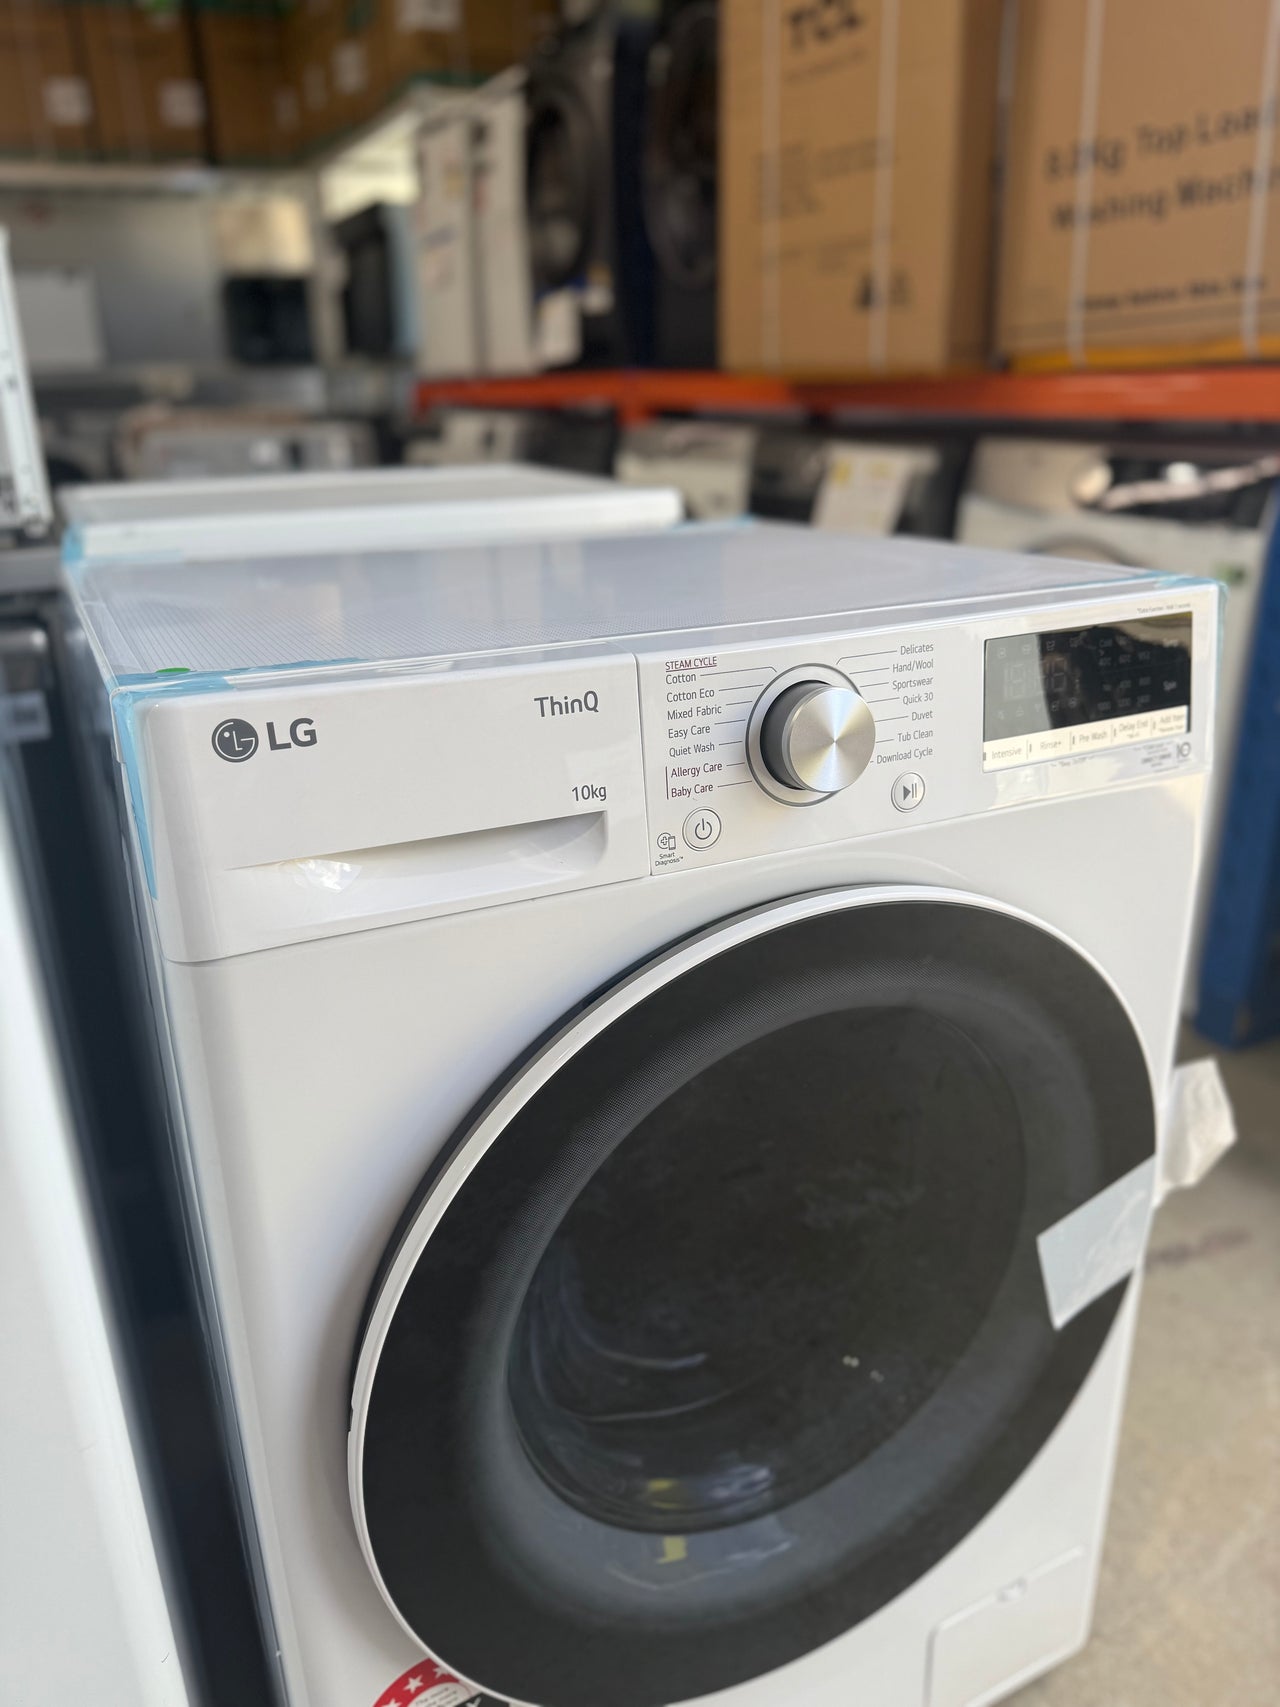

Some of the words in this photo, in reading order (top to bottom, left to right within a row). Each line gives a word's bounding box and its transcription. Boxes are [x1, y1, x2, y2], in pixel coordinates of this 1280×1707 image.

[900, 644, 934, 656] Delicates
[665, 659, 692, 671] STEAM
[693, 656, 717, 668] CYCLE
[892, 659, 934, 673] Hand/Wool
[665, 673, 697, 685] Cotton
[892, 677, 933, 692] Sportswear
[666, 691, 697, 703] Cotton
[699, 688, 715, 699] Eco
[902, 695, 922, 705] Quick
[924, 692, 934, 702] 30
[533, 690, 599, 718] ThinQ
[667, 707, 693, 720] Mixed
[696, 705, 722, 717] Fabric
[911, 710, 933, 721] Duvet
[266, 717, 318, 751] LG
[668, 728, 688, 740] Easy
[690, 725, 711, 736] Care
[897, 732, 911, 742] Tub
[912, 729, 934, 740] Clean
[669, 746, 691, 758] Quiet
[693, 742, 715, 753] Wash
[876, 749, 912, 764] Download
[913, 747, 933, 759] Cycle
[991, 746, 1022, 760] Intensive
[670, 766, 701, 778] Allergy
[702, 762, 723, 773] Care
[571, 784, 607, 802] 10kg
[671, 787, 692, 798] Baby
[694, 783, 714, 794] Care
[659, 852, 675, 860] Smart
